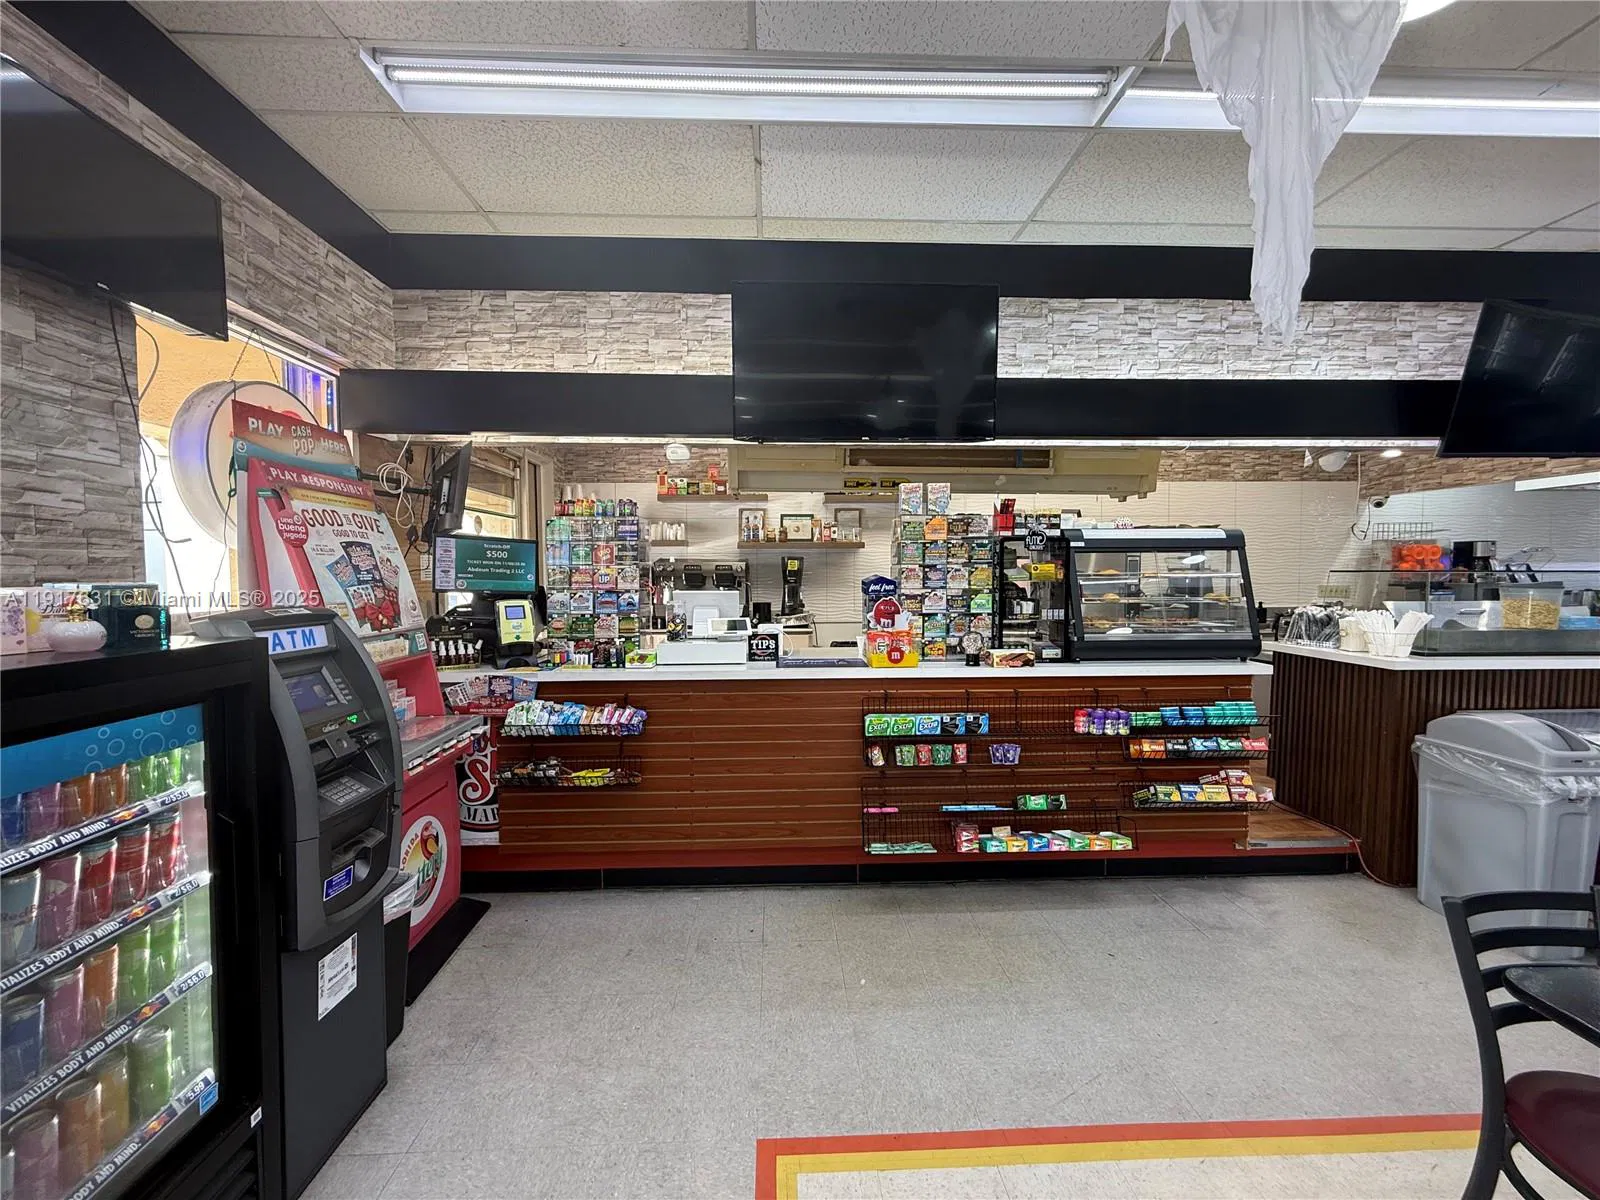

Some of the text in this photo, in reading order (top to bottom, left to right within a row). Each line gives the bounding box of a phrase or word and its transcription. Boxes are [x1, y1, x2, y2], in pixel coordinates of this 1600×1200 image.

[248, 416, 284, 437] PLAY
[291, 425, 312, 437] CASH
[293, 438, 314, 456] POP
[269, 467, 364, 496] PLAY RESPONSIBLY
[278, 519, 306, 533] buena
[301, 508, 344, 528] GOOD
[352, 512, 385, 534] GIVE
[281, 531, 307, 541] jugada
[332, 528, 369, 540] GOOD TO GET
[485, 550, 508, 559] $500
[868, 583, 895, 592] feel free
[271, 628, 317, 652] ATM
[750, 640, 776, 649] TIPS
[891, 651, 900, 659] m
[868, 720, 889, 732] Extra
[893, 720, 914, 732] Extra
[919, 720, 938, 731] Extra
[31, 839, 59, 857] BODY
[60, 829, 81, 844] AND
[44, 946, 73, 966] BODY
[73, 935, 95, 952] AND
[5, 1074, 58, 1114] VITALIZES
[57, 1057, 85, 1078] BODY
[85, 1041, 106, 1059] AND
[95, 1159, 116, 1183] AND
